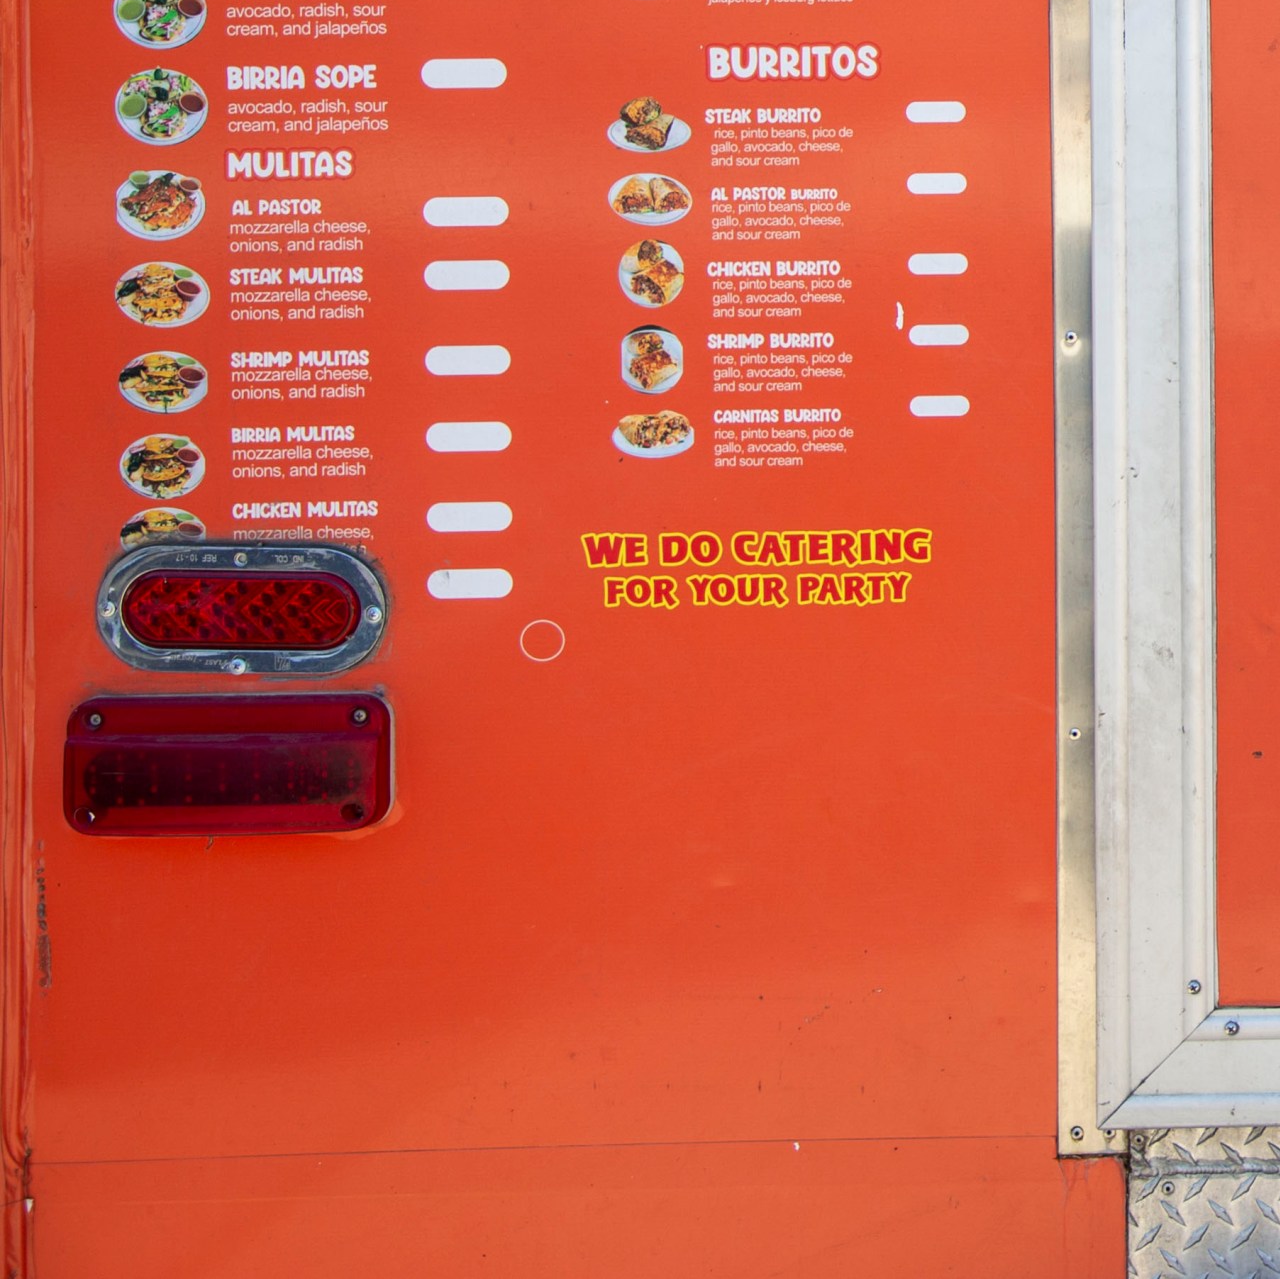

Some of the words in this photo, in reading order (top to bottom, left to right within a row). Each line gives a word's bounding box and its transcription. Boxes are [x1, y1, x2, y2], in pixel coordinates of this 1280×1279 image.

[708, 44, 878, 79] BURRITOS
[226, 65, 306, 91] BIRRIA
[314, 63, 377, 90] SOPE
[704, 108, 752, 125] STEAK
[756, 107, 822, 124] BURRITO
[714, 129, 738, 139] rice,
[740, 128, 769, 141] pinto
[770, 127, 807, 139] beans,
[812, 128, 837, 140] pico
[838, 126, 854, 138] de
[227, 150, 353, 179] MULITAS
[710, 187, 729, 202] AL
[732, 186, 786, 201] PASTOR
[790, 188, 838, 201] BURRITO
[231, 199, 253, 217] AL
[258, 198, 322, 216] PASTOR
[229, 219, 310, 235] mozzarella
[312, 219, 370, 234] cheese,
[229, 240, 282, 253] onions,
[286, 237, 315, 252] and
[318, 236, 363, 252] radish
[229, 267, 283, 286] STEAK
[288, 266, 364, 285] MULITAS
[706, 260, 772, 278] CHICKEN
[775, 259, 841, 277] BURRITO
[707, 333, 765, 350] SHRIMP
[769, 332, 835, 349] BURRITO
[230, 350, 293, 369] SHRIMP
[298, 349, 370, 369] MULITAS
[713, 408, 779, 424] CARNITAS
[783, 408, 842, 423] BURRITO
[231, 426, 281, 444] BIRRIA
[286, 425, 355, 443] MULITAS
[231, 501, 302, 520] CHICKEN
[307, 500, 379, 518] MULITAS
[580, 532, 649, 569] WE
[658, 530, 724, 567] DO
[730, 527, 933, 569] CATERING
[603, 574, 681, 610] FOR
[685, 573, 790, 609] YOUR
[796, 571, 913, 607] PARTY
